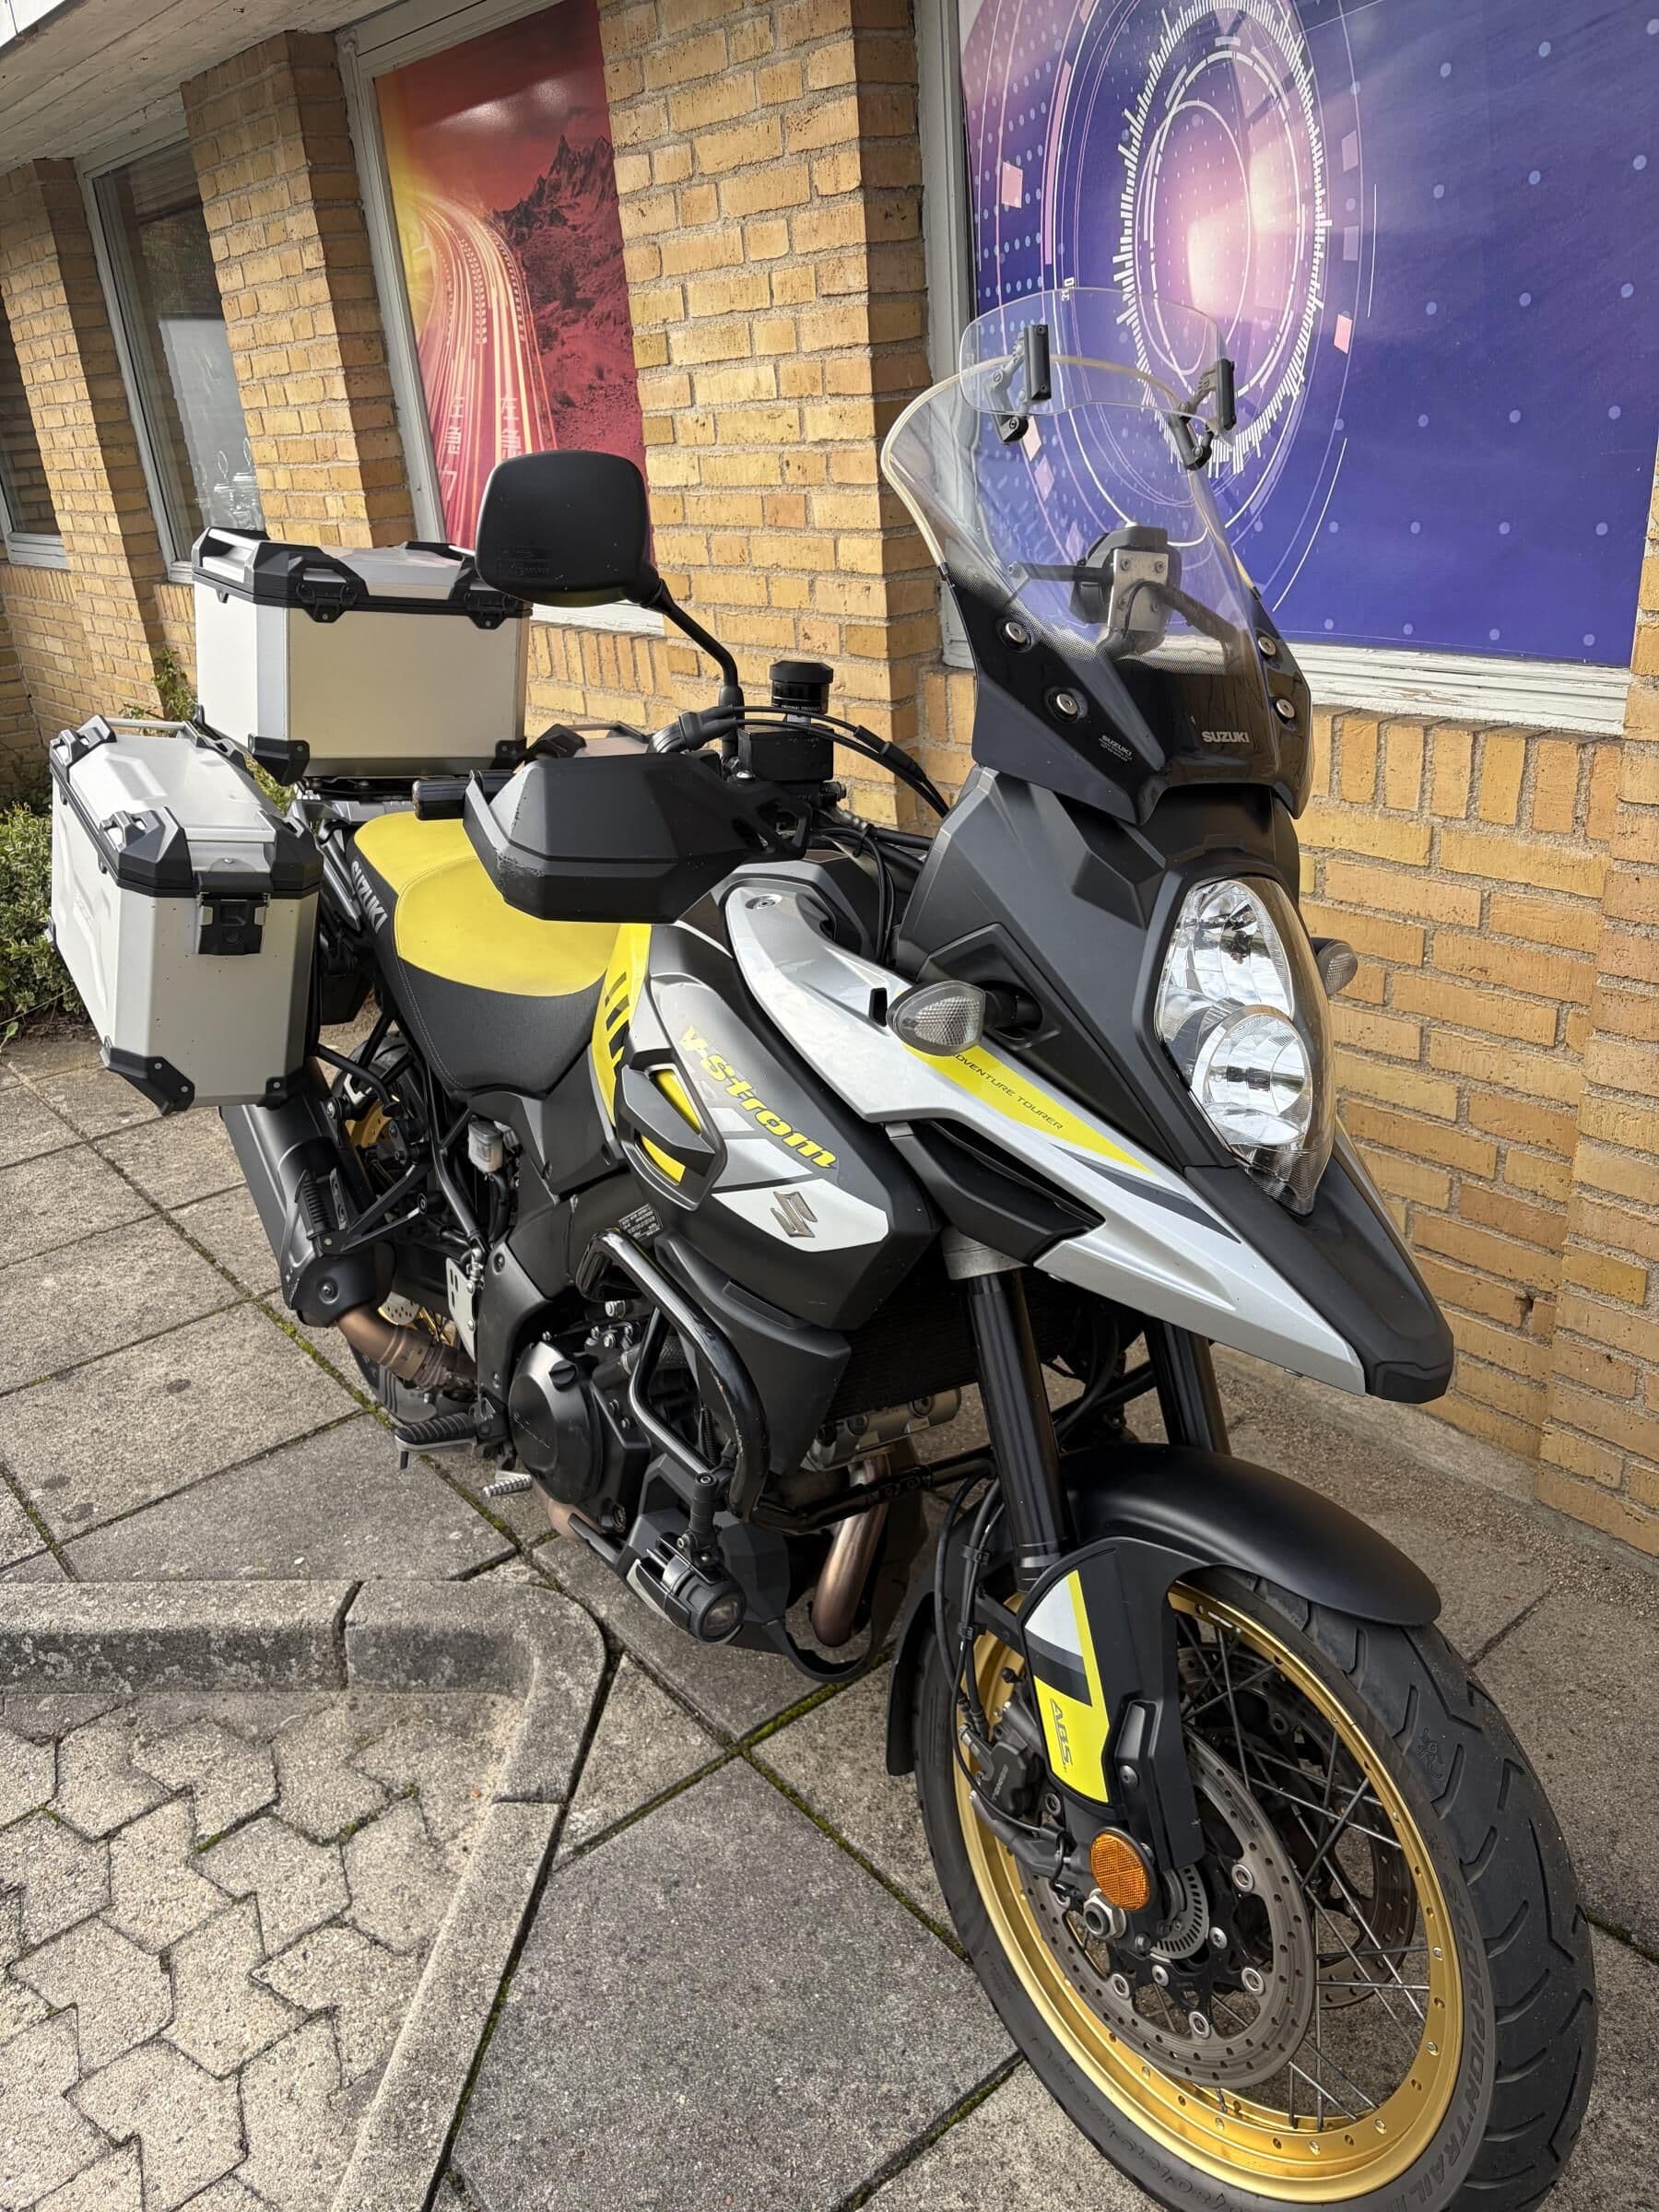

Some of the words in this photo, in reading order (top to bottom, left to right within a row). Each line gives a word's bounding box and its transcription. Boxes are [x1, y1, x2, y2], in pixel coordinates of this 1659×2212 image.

[1101, 735, 1133, 757] SUZUKI
[1201, 730, 1250, 744] SUZUKI
[351, 860, 388, 935] SUZUKI
[954, 1053, 1016, 1097] DVENTURE
[1017, 1095, 1064, 1130] TOURER
[1050, 1698, 1074, 1766] ABS
[1408, 2115, 1472, 2205] TRAIL
